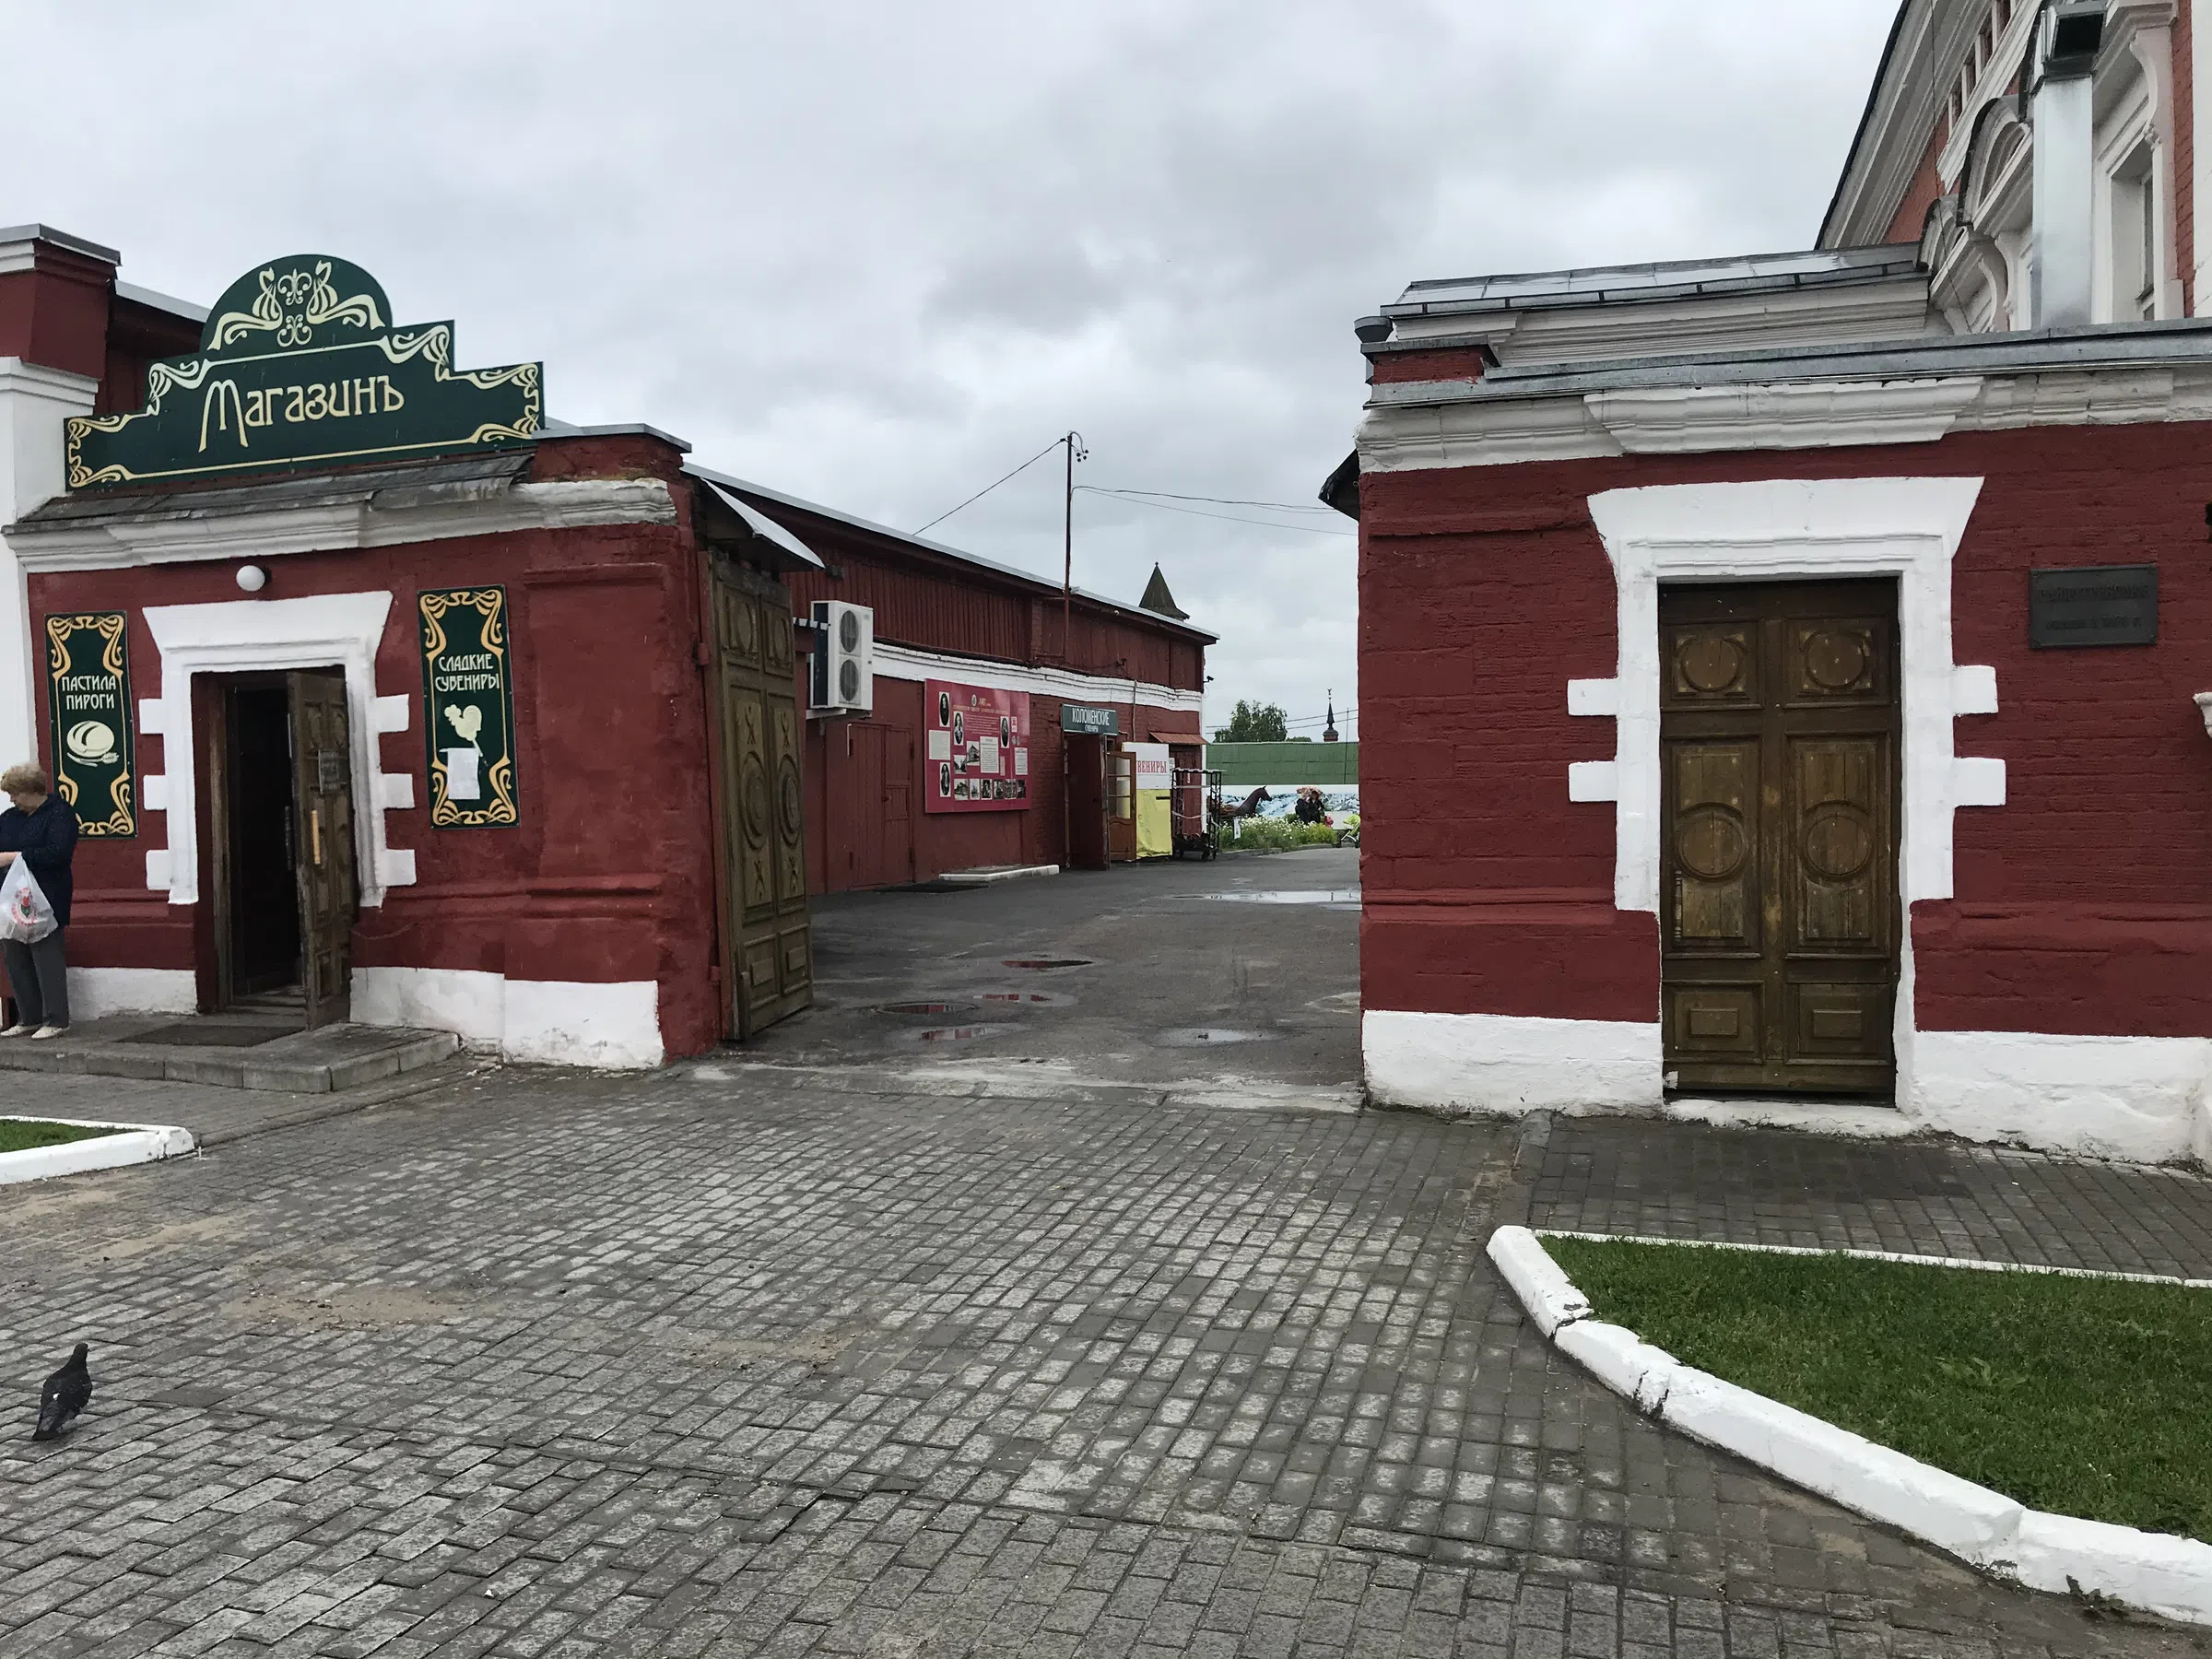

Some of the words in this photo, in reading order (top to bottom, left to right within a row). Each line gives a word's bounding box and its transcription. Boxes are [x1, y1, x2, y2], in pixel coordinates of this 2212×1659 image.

[198, 375, 405, 453] Магазинъ
[439, 653, 494, 672] СЛАДКИЕ
[62, 675, 117, 691] ПАСТИЛА
[435, 673, 500, 692] СУВЕНИРЫ
[66, 693, 115, 710] ПИРОГИ
